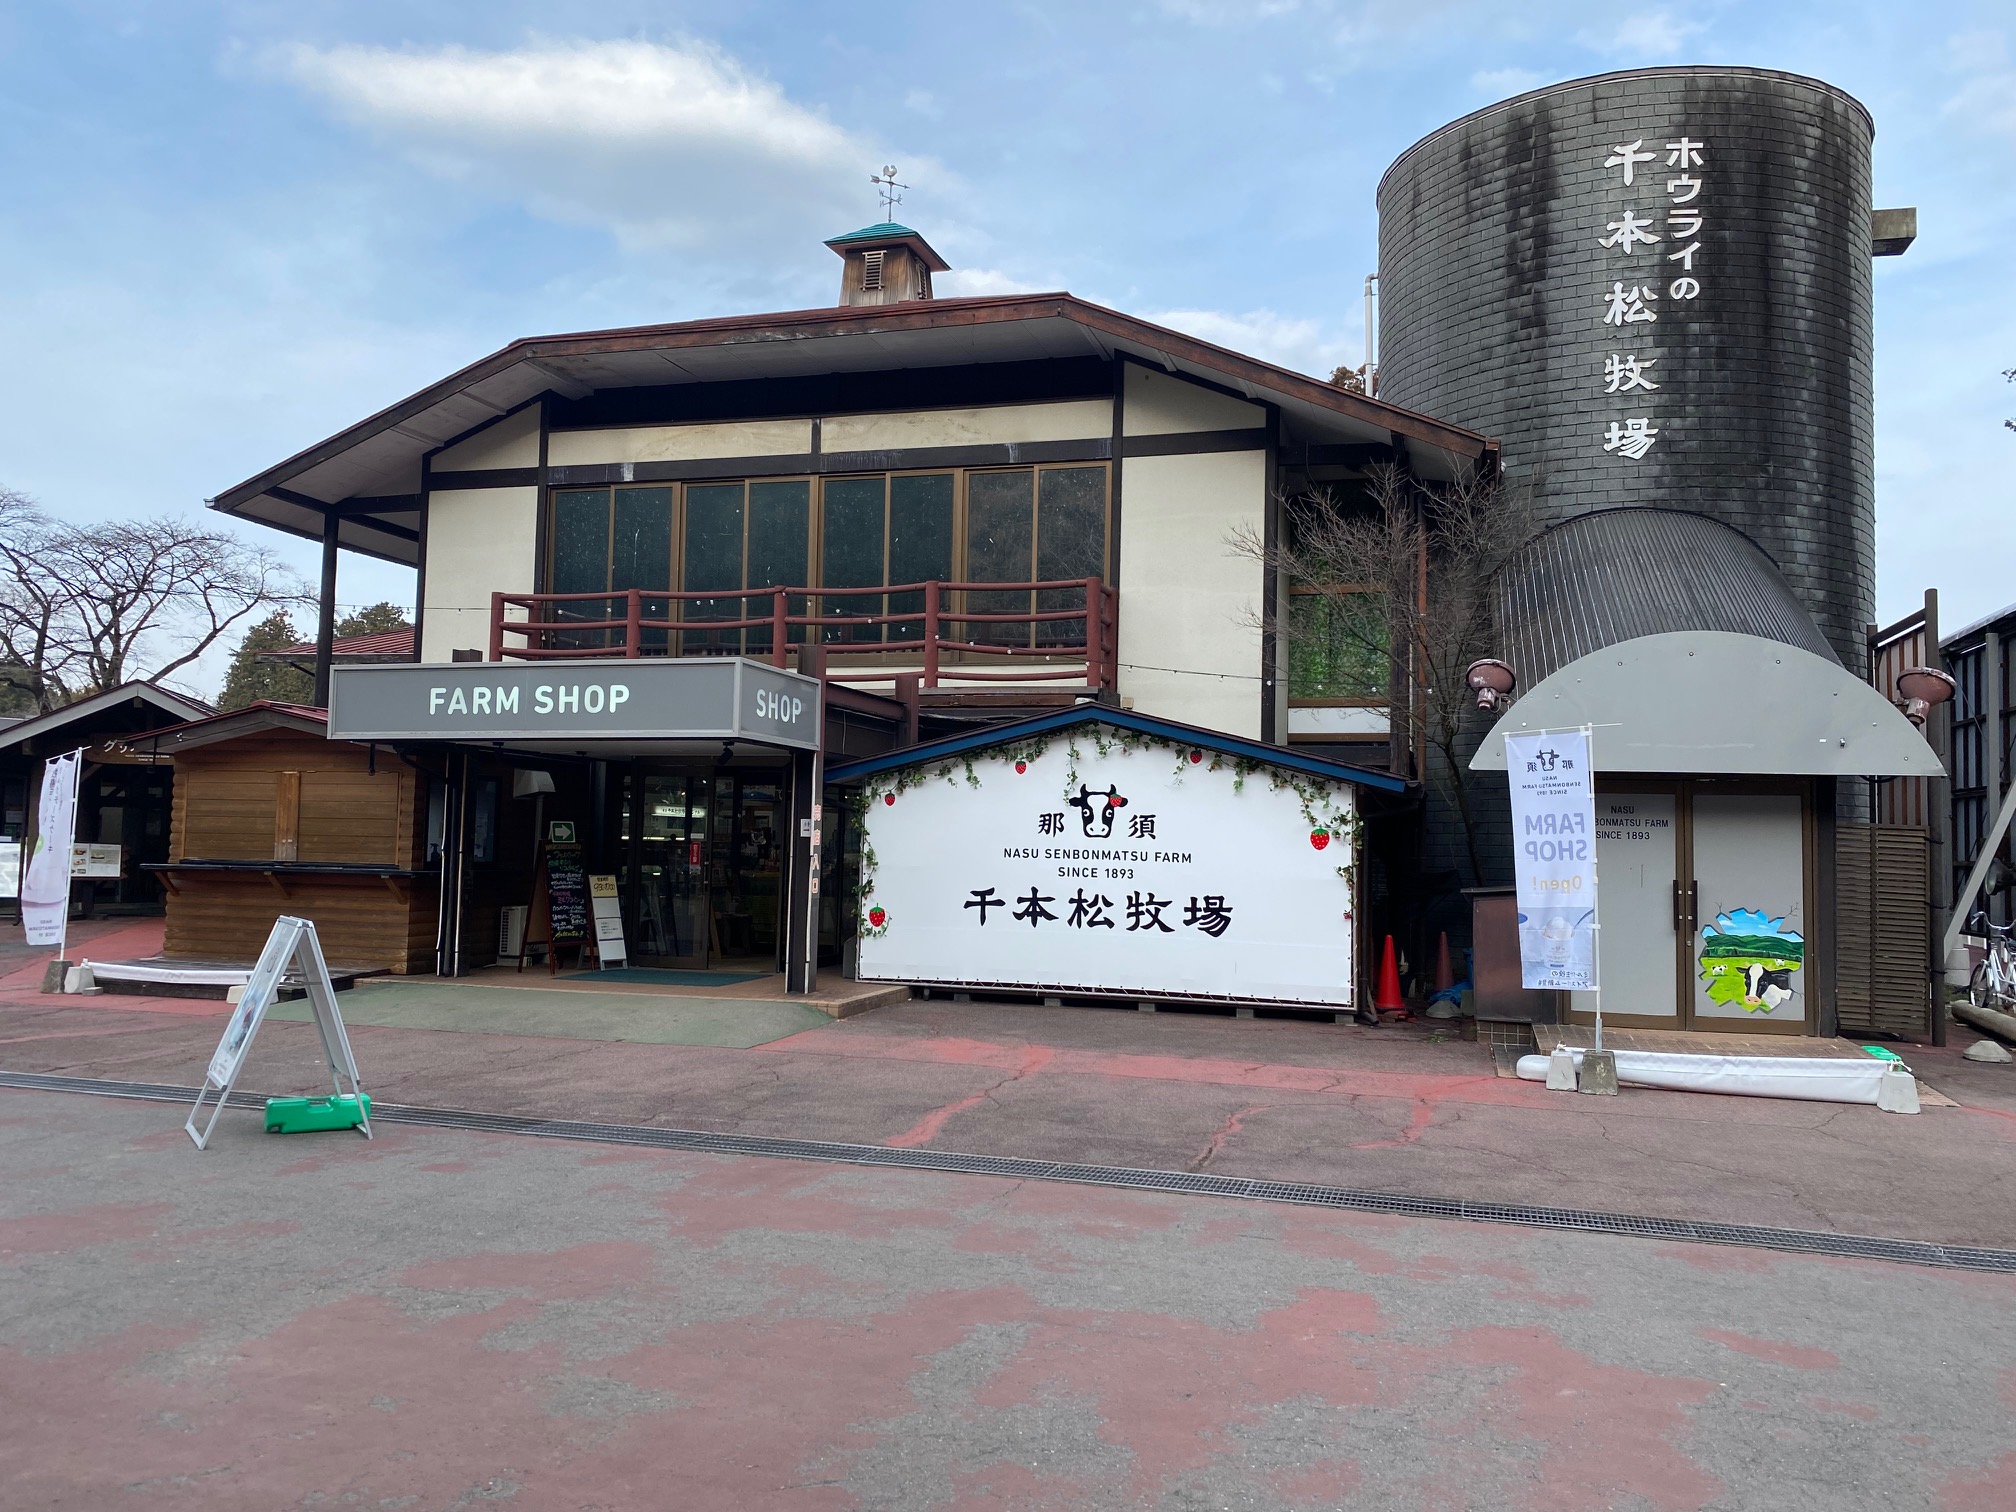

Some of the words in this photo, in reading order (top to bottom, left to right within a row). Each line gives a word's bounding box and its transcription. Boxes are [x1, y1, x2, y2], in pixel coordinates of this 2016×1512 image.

[1665, 137, 1704, 301] ホウライの
[1597, 138, 1662, 461] 千本松牧場
[429, 685, 520, 716] FARM
[533, 683, 631, 715] SHOP
[755, 688, 803, 725] SHOP
[103, 739, 135, 754] グッ
[1610, 805, 1635, 815] NASU
[1038, 812, 1066, 838] 那
[1127, 814, 1157, 840] 須
[1595, 818, 1641, 827] BONMATSU
[1645, 819, 1669, 828] FARM
[1596, 831, 1622, 840] SINCE
[1626, 831, 1650, 840] 1893
[1003, 847, 1040, 859] NASU
[1044, 848, 1149, 863] SENBONMATSU
[1154, 850, 1192, 864] FARM
[1057, 866, 1099, 879] SINCE
[1104, 867, 1135, 880] 1893
[963, 885, 1233, 938] 千本松牧場
